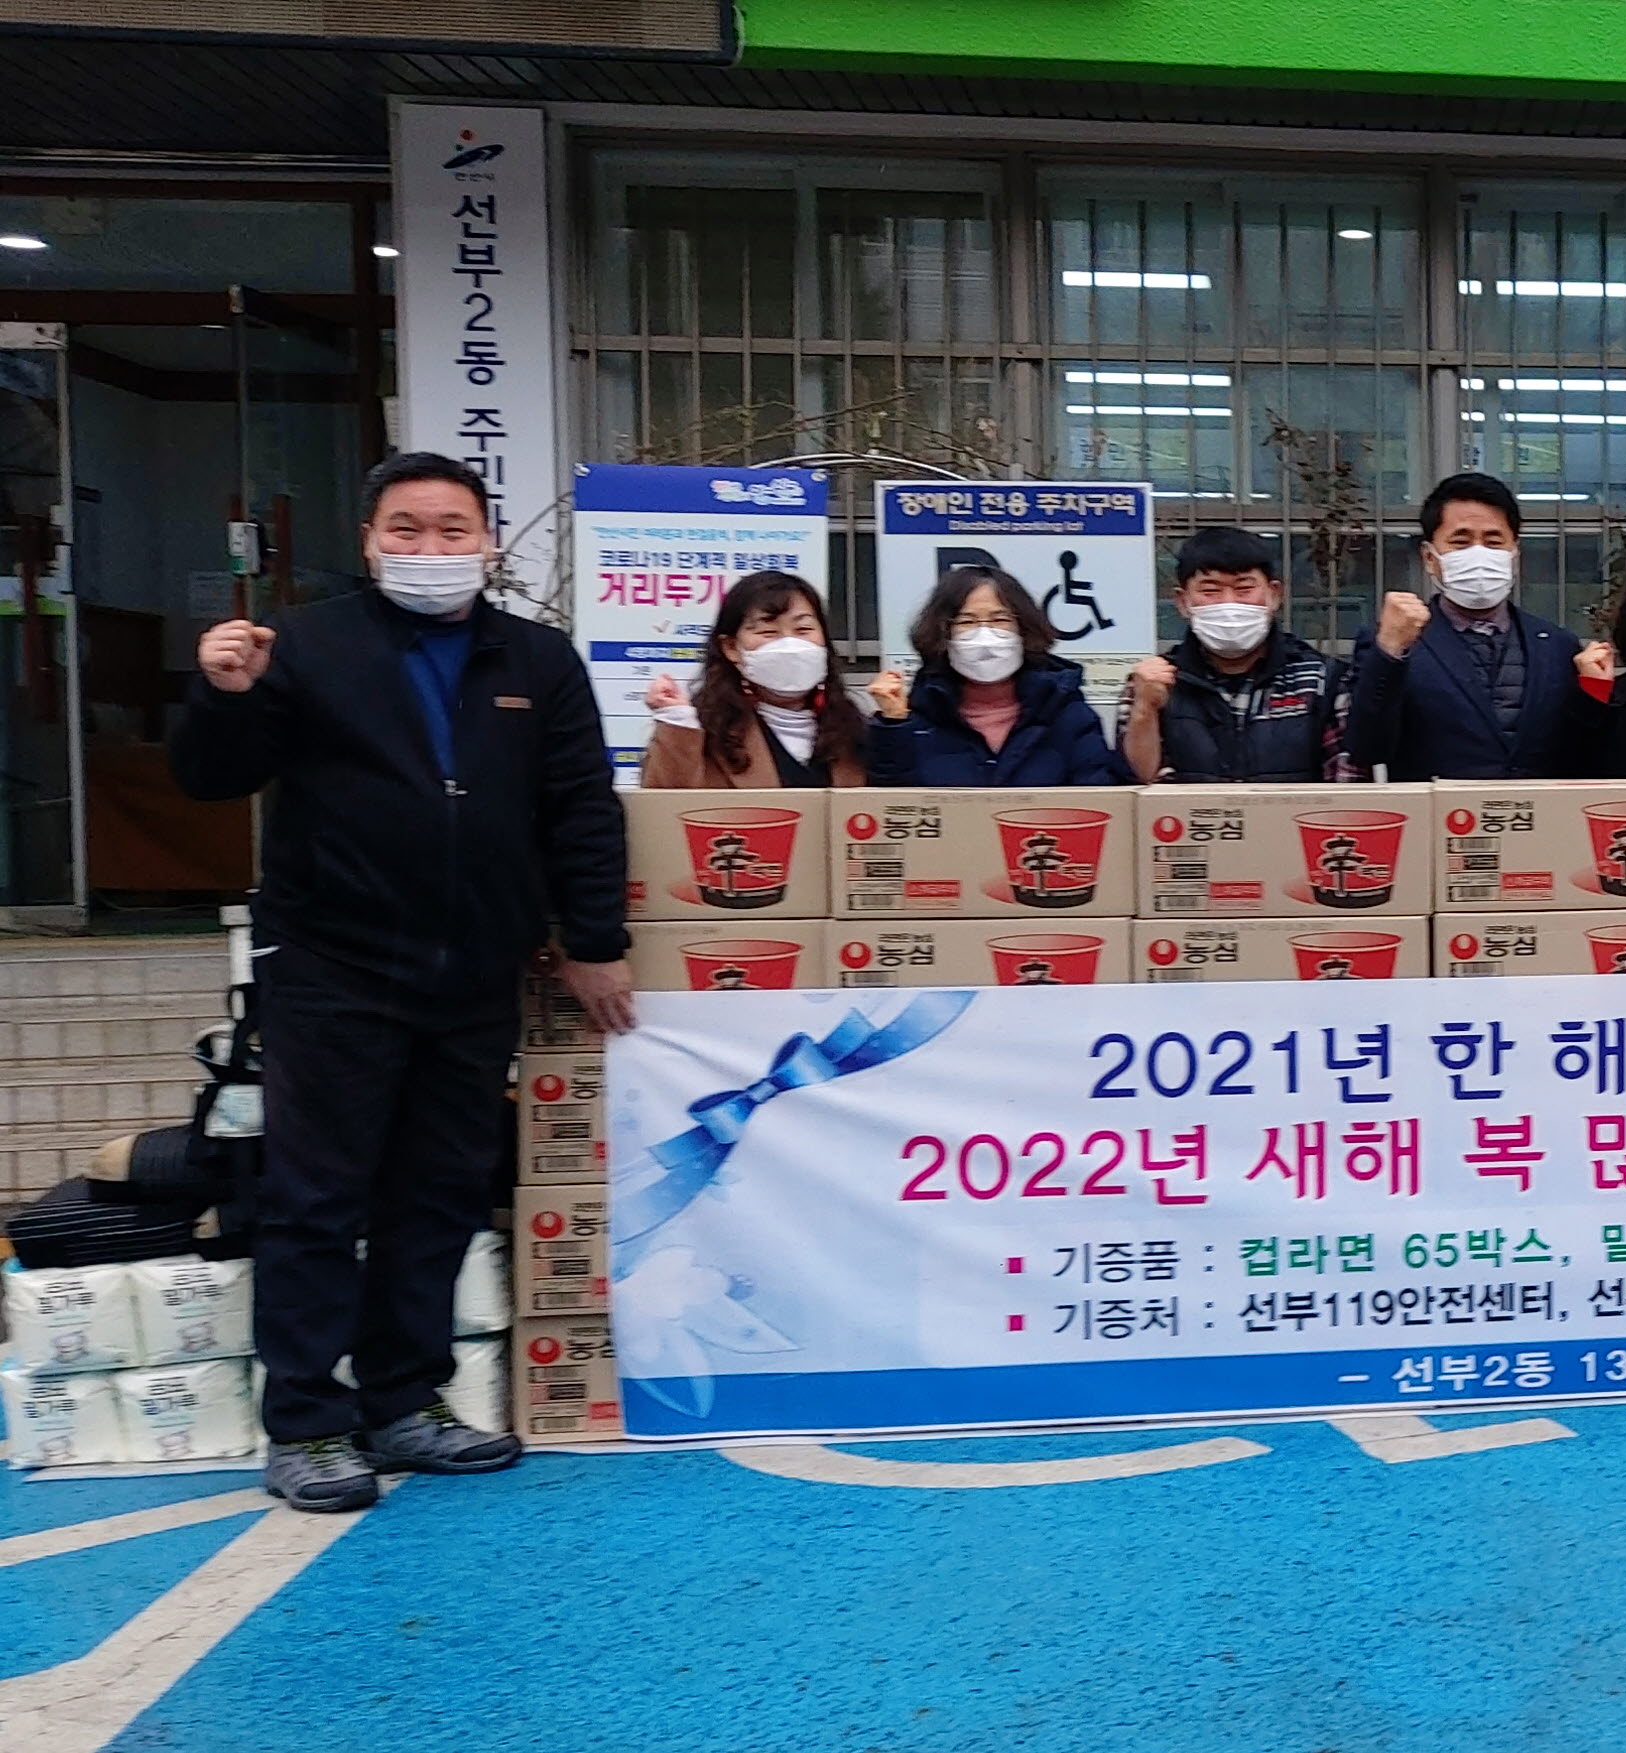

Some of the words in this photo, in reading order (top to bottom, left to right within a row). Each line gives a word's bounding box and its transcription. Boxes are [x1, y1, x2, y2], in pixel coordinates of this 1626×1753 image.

[451, 195, 506, 387] 선부2동
[896, 492, 974, 516] 장애인
[979, 492, 1030, 517] 전용
[1036, 492, 1137, 517] 주차구역
[598, 549, 672, 568] 코로나19
[677, 551, 727, 569] 단계적
[733, 552, 799, 570] 일상회복
[597, 572, 728, 608] 거리두기
[882, 817, 942, 839] 농심
[1188, 820, 1244, 841] 농심
[1480, 811, 1534, 833] 농심
[877, 944, 935, 966] 농심
[1181, 942, 1238, 963] 농심
[1483, 936, 1537, 957] 농심
[1088, 1023, 1392, 1103] 2021년
[1431, 1020, 1514, 1099] 한
[1551, 1017, 1626, 1095] 해
[899, 1123, 1208, 1204] 2022년
[1245, 1117, 1421, 1199] 새해
[1463, 1114, 1545, 1191] 복
[1053, 1240, 1181, 1283] 기증품
[1239, 1233, 1377, 1277] 컵라면
[1403, 1228, 1570, 1268] 65박스,
[1053, 1296, 1181, 1341] 기증처
[1239, 1281, 1568, 1333] 선부119안전센터,
[1391, 1350, 1556, 1393] 선부2동
